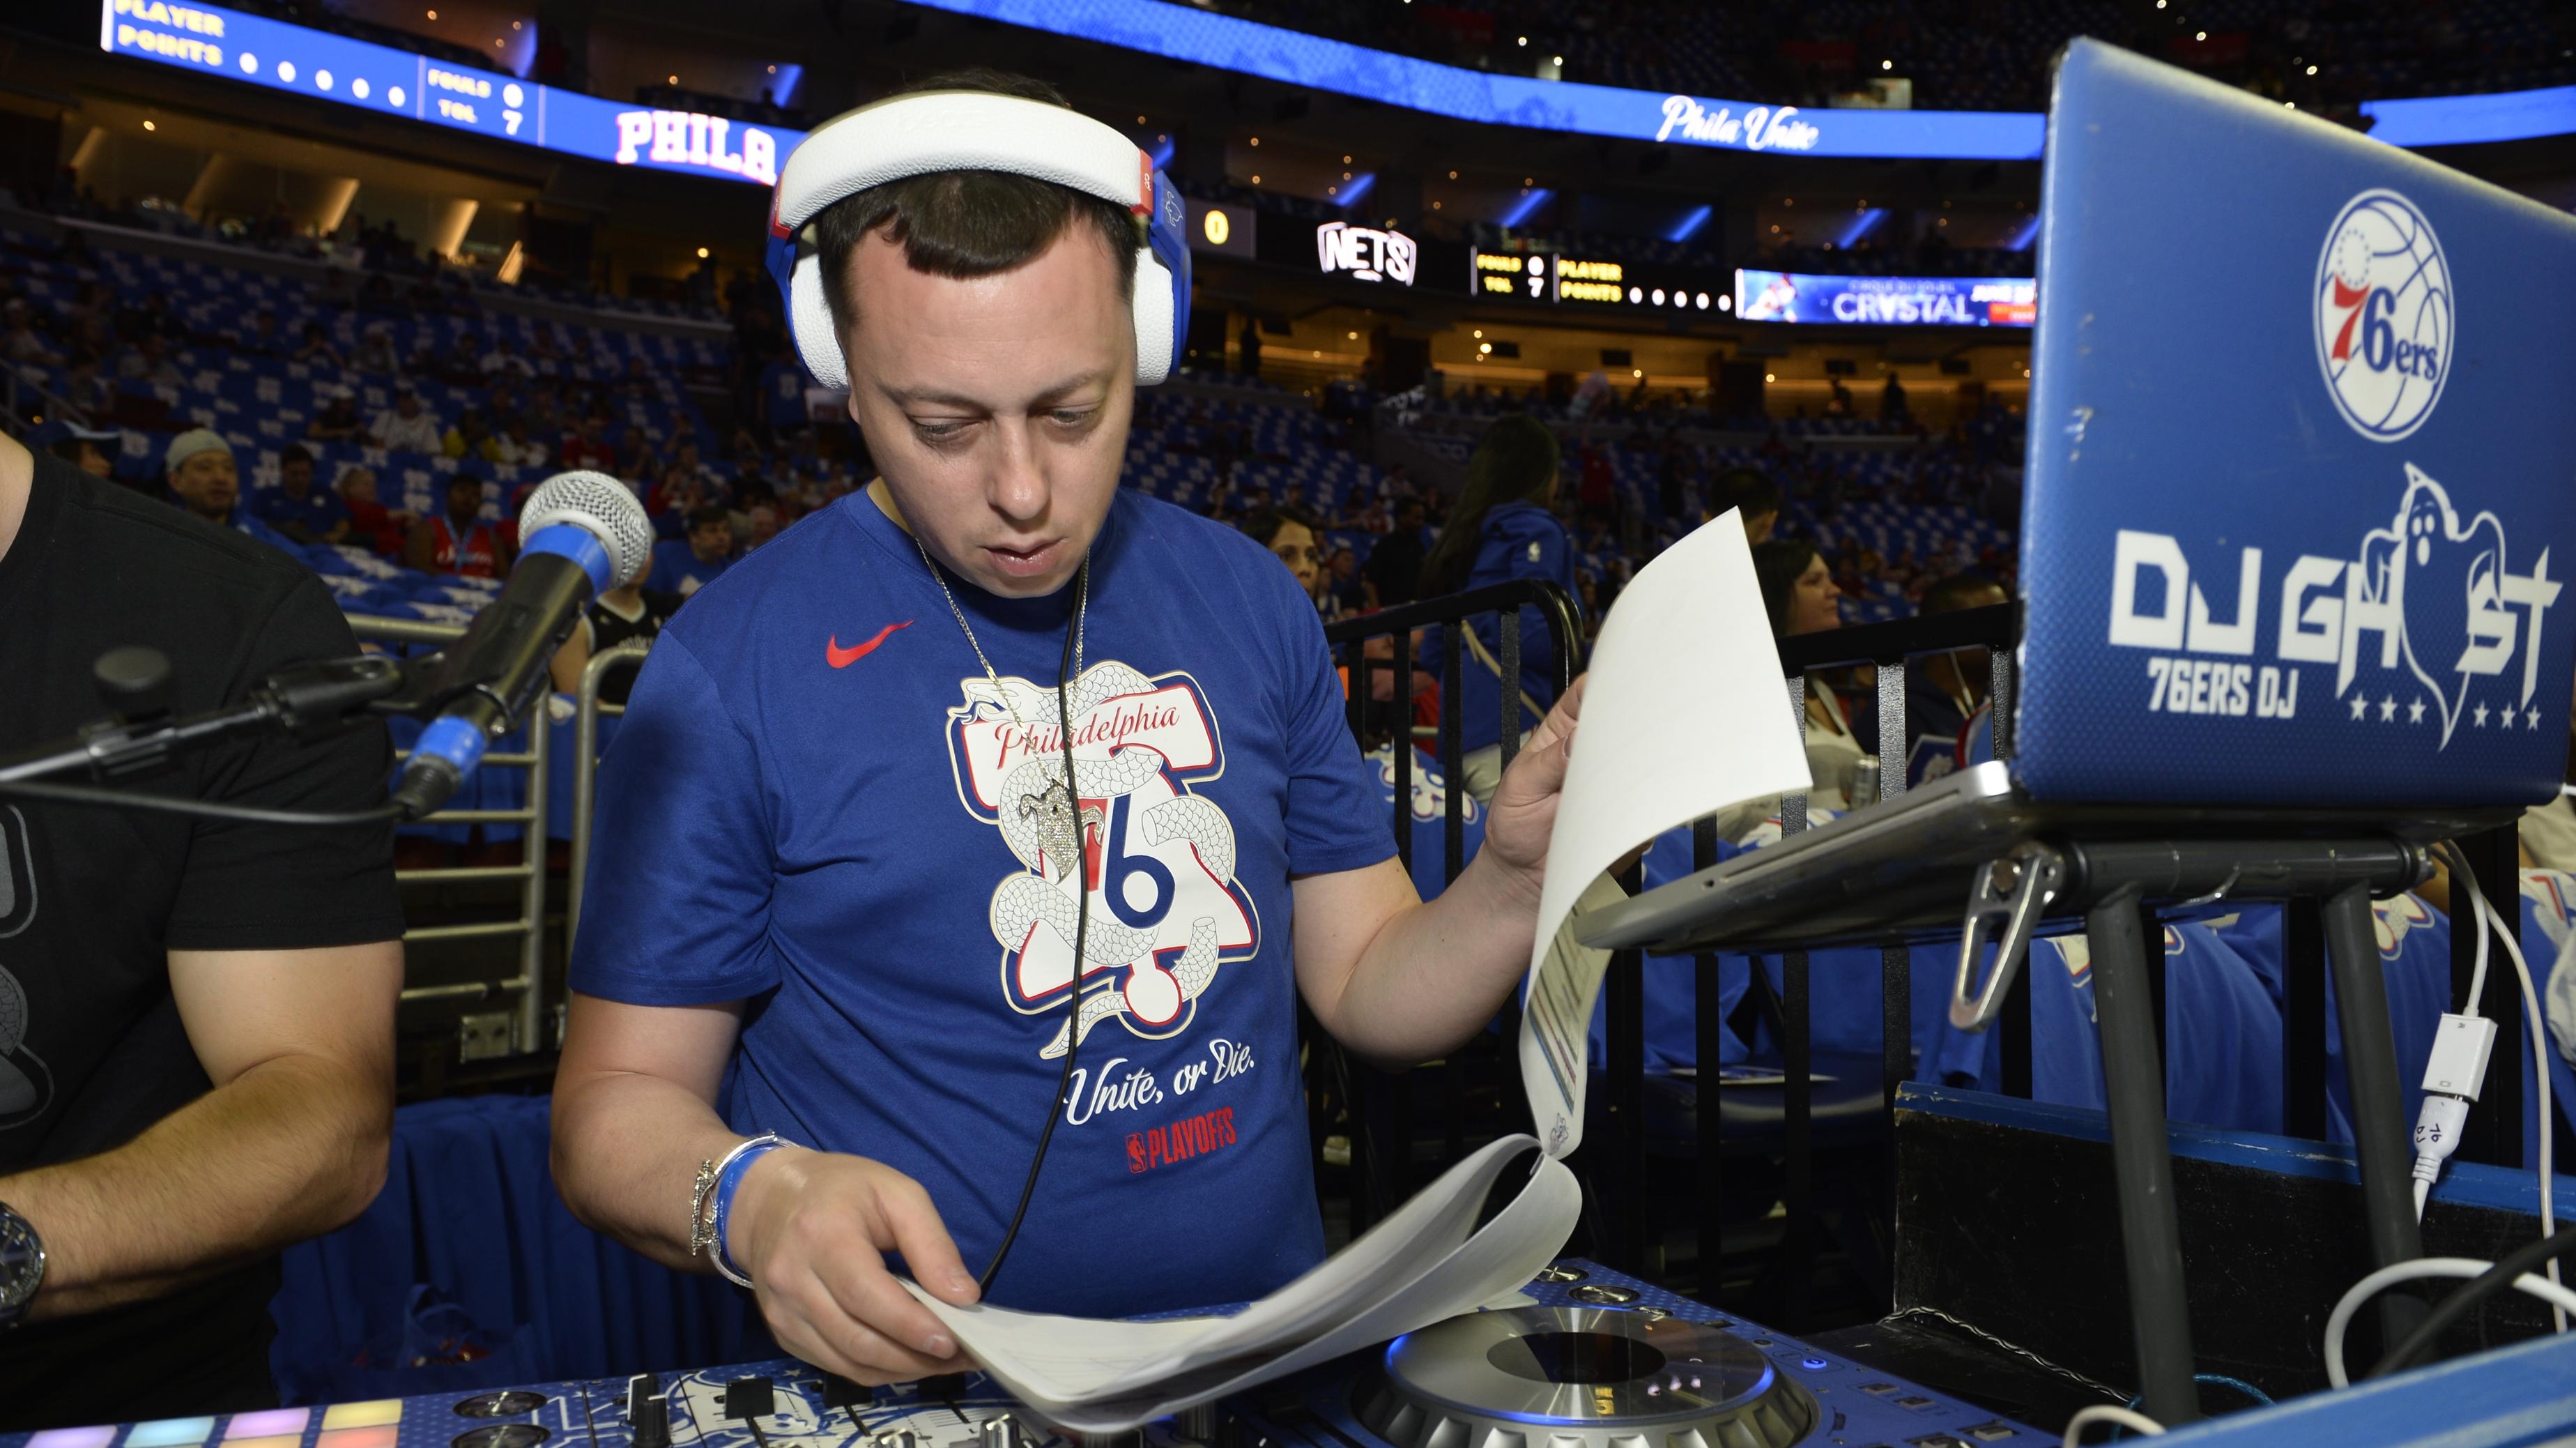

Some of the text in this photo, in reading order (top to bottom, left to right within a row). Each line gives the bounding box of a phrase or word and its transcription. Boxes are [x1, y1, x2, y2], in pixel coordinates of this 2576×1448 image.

[114, 0, 224, 38] PLAYER
[118, 24, 222, 66] POINTS
[428, 68, 491, 98] FOULS
[502, 109, 523, 135] 7
[1655, 95, 1742, 144] Phila
[615, 110, 777, 186] PHILA
[1325, 227, 1410, 282] NETS
[1528, 277, 1544, 298] 7
[1832, 293, 1975, 322] CRYSTAL
[2331, 273, 2438, 381] 76ers
[2109, 529, 2262, 655] DJ
[2148, 657, 2299, 718] 76ERS DJ
[995, 703, 1180, 770] Philadelphia
[1063, 1039, 1255, 1126] Unite, or Die.
[1149, 1106, 1237, 1168] PLAYOFFS
